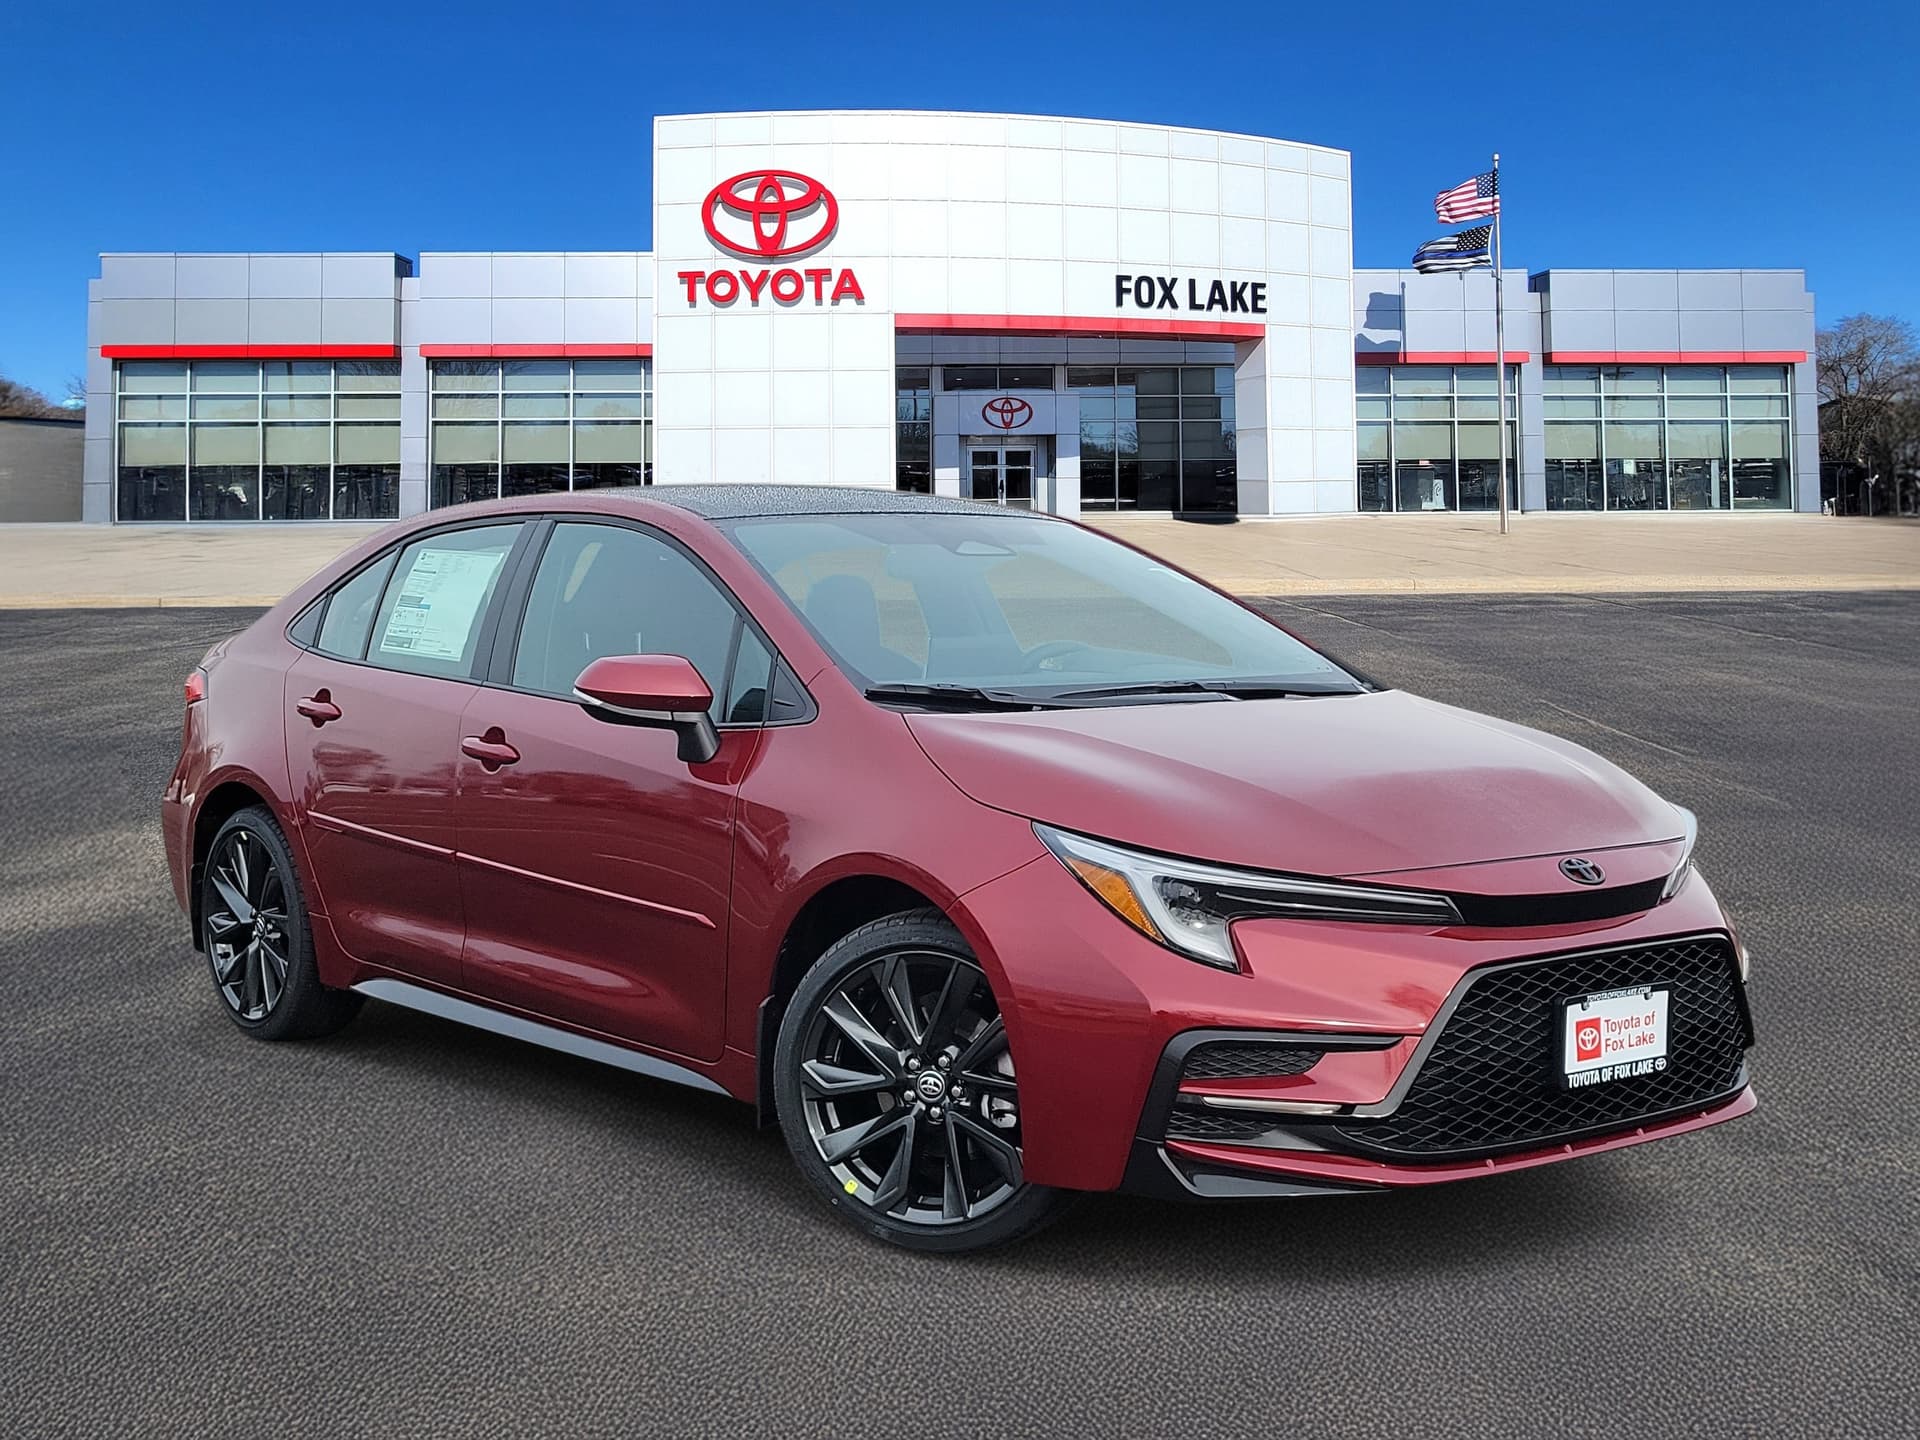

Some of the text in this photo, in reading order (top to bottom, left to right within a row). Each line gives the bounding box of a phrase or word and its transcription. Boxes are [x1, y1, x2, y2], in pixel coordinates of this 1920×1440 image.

[678, 268, 865, 306] TOYOTA
[1115, 275, 1268, 314] FOX LAKE
[1604, 1010, 1656, 1035] Toyota of
[1604, 1031, 1655, 1053] Fox Lake
[1568, 1059, 1654, 1088] TOYOTA OF FOX LAKE
